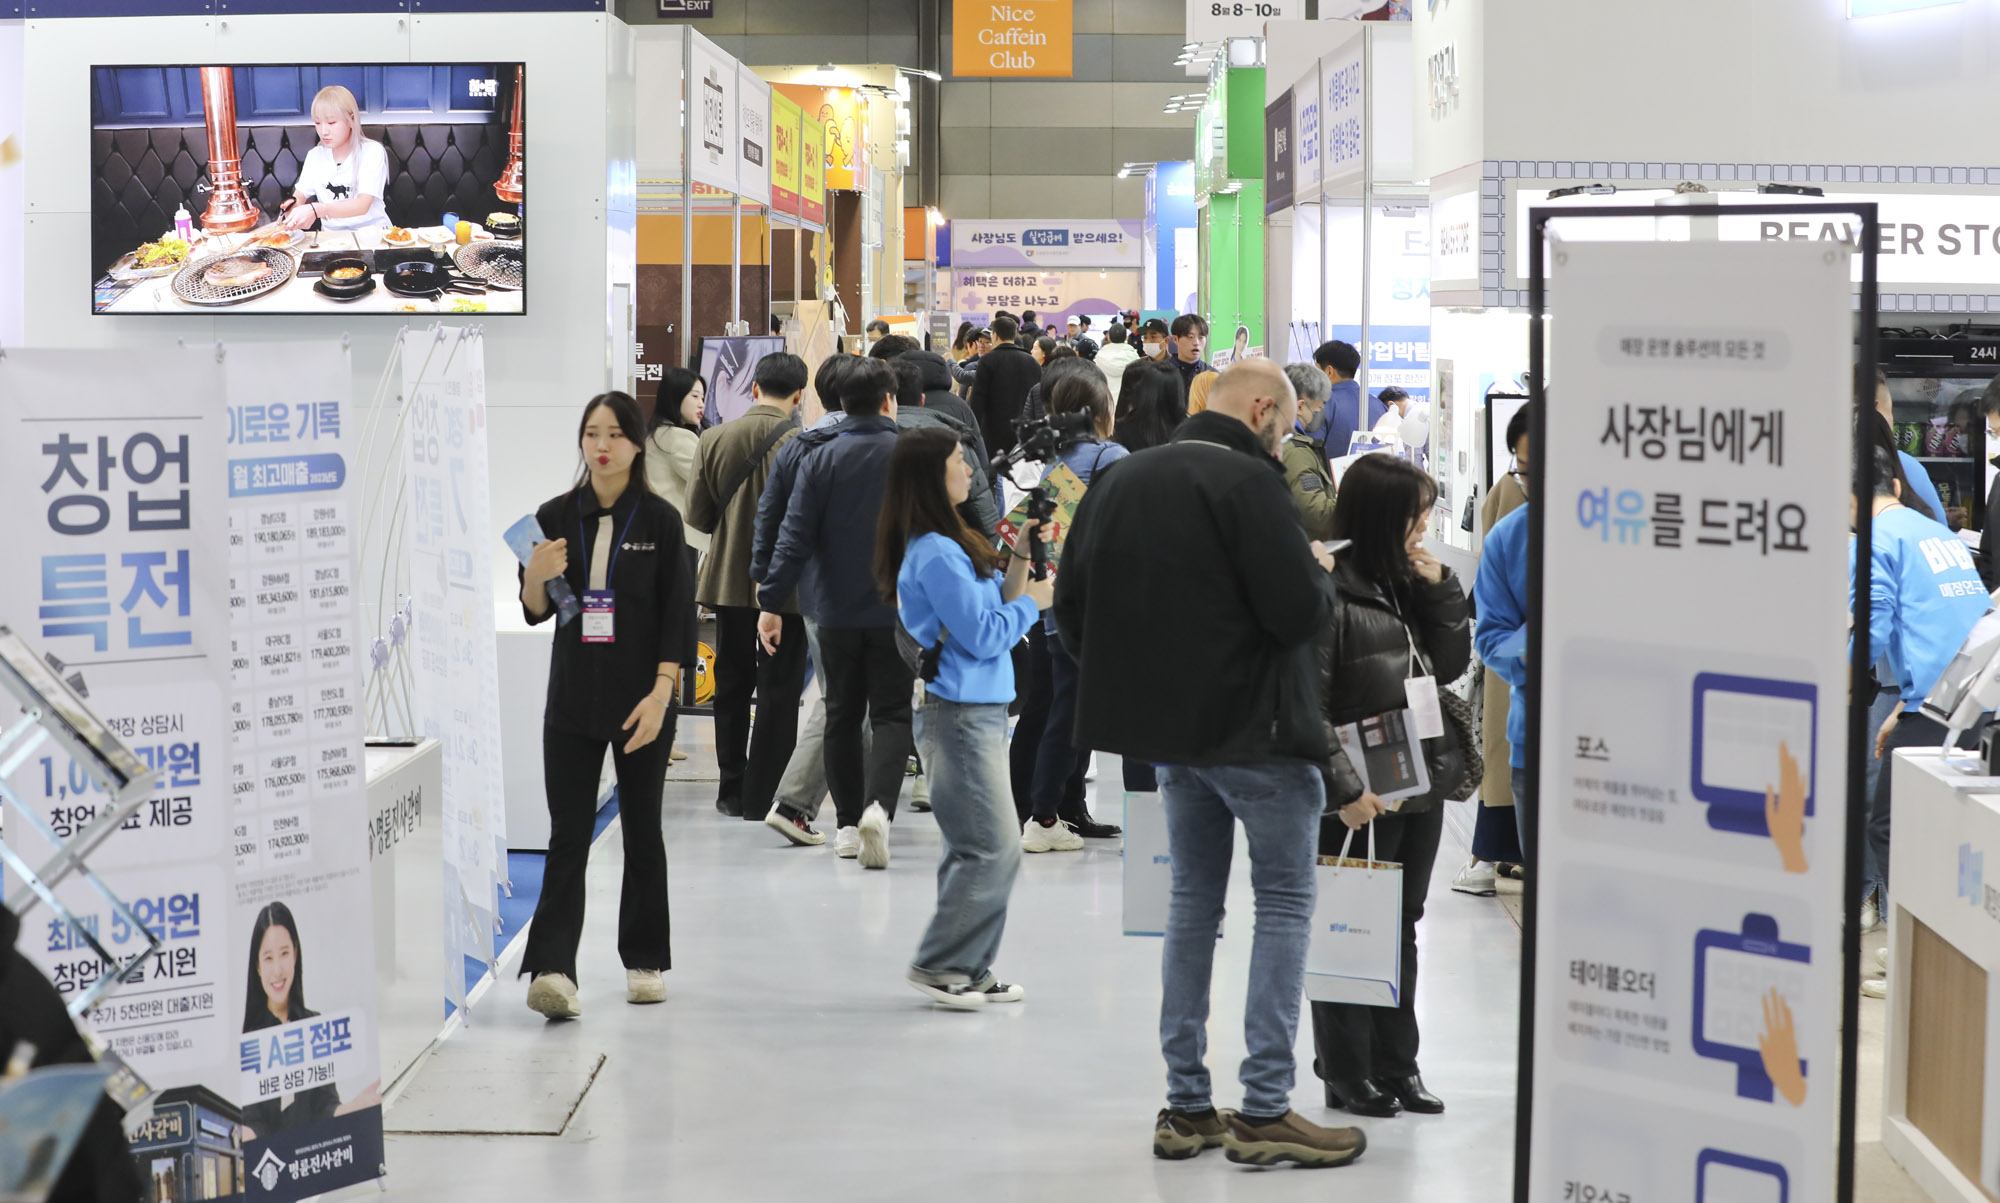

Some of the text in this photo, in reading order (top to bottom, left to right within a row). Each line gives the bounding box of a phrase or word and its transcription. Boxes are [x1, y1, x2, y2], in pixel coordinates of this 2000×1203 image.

[686, 0, 710, 10] EXIT
[991, 5, 1036, 21] Nice
[1211, 3, 1230, 16] 8월
[978, 27, 1047, 45] Caffein
[989, 51, 1035, 69] Club
[971, 231, 1122, 245] 사장님도 실업급여 받으세요!
[963, 276, 1037, 287] 혜택은 더하고
[987, 295, 1059, 307] 부담은 나누고
[1970, 346, 1997, 360] 24시
[296, 401, 341, 441] 기록
[1600, 403, 1784, 468] 사장님에게
[40, 431, 191, 536] 창업
[233, 465, 248, 490] 월
[252, 461, 309, 489] 최고매출
[1577, 486, 1809, 556] 여유를 드려요
[38, 549, 192, 652] 특전
[141, 713, 185, 736] 상담시
[1575, 736, 1611, 761] 포스
[149, 796, 193, 827] 제공
[153, 947, 197, 979] 지원
[1569, 959, 1656, 999] 테이블오더
[120, 1000, 164, 1021] 5천만원
[167, 992, 214, 1015] 대출지원
[240, 1016, 352, 1074] 특 A급 점포
[259, 1062, 335, 1096] 바로 상담 가능!!
[288, 1144, 354, 1180] 명륜진사갈비
